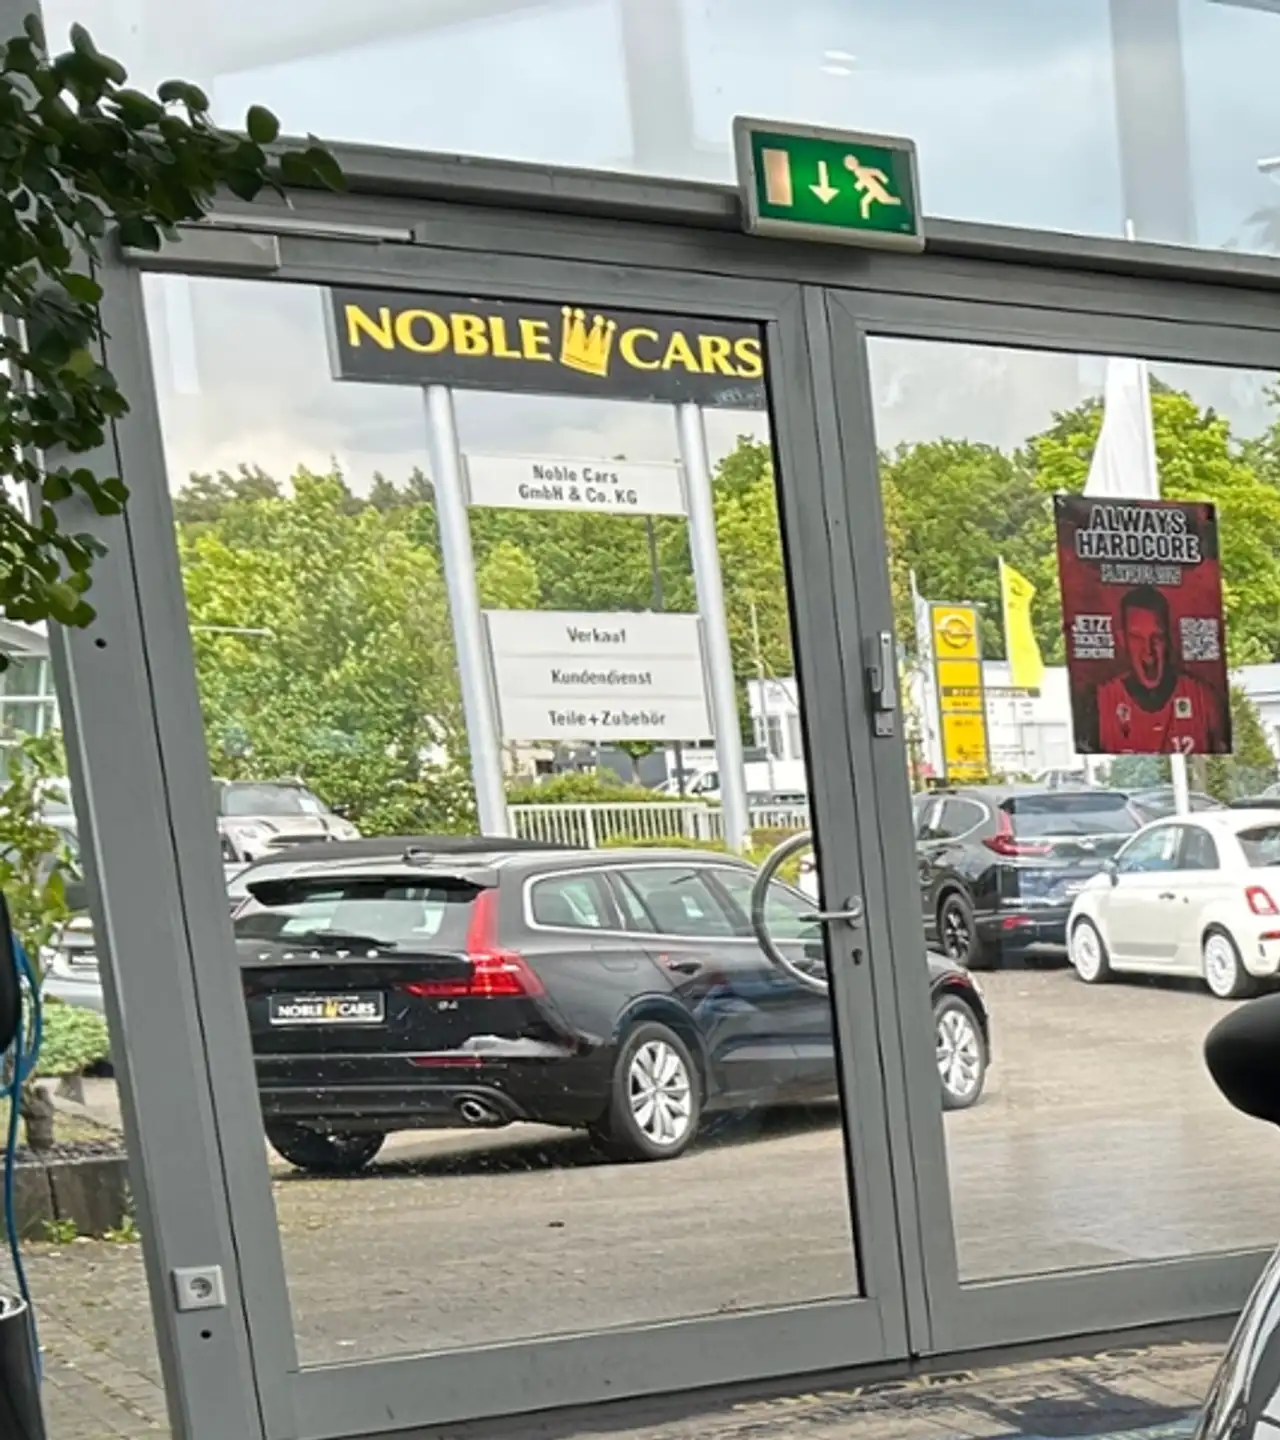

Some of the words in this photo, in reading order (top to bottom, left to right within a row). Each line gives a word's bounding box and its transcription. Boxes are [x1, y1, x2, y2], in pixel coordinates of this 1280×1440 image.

[344, 304, 553, 362] NOBLE
[619, 327, 764, 379] CARS
[532, 464, 577, 481] Noble
[582, 467, 618, 484] Cars
[518, 483, 564, 501] GmbH
[568, 485, 581, 501] &
[1090, 505, 1187, 535] ALWAYS
[1077, 530, 1201, 563] HARDCORE
[567, 627, 626, 643] Verkauf
[551, 669, 652, 686] Kundendienst
[338, 1002, 376, 1016] CARS
